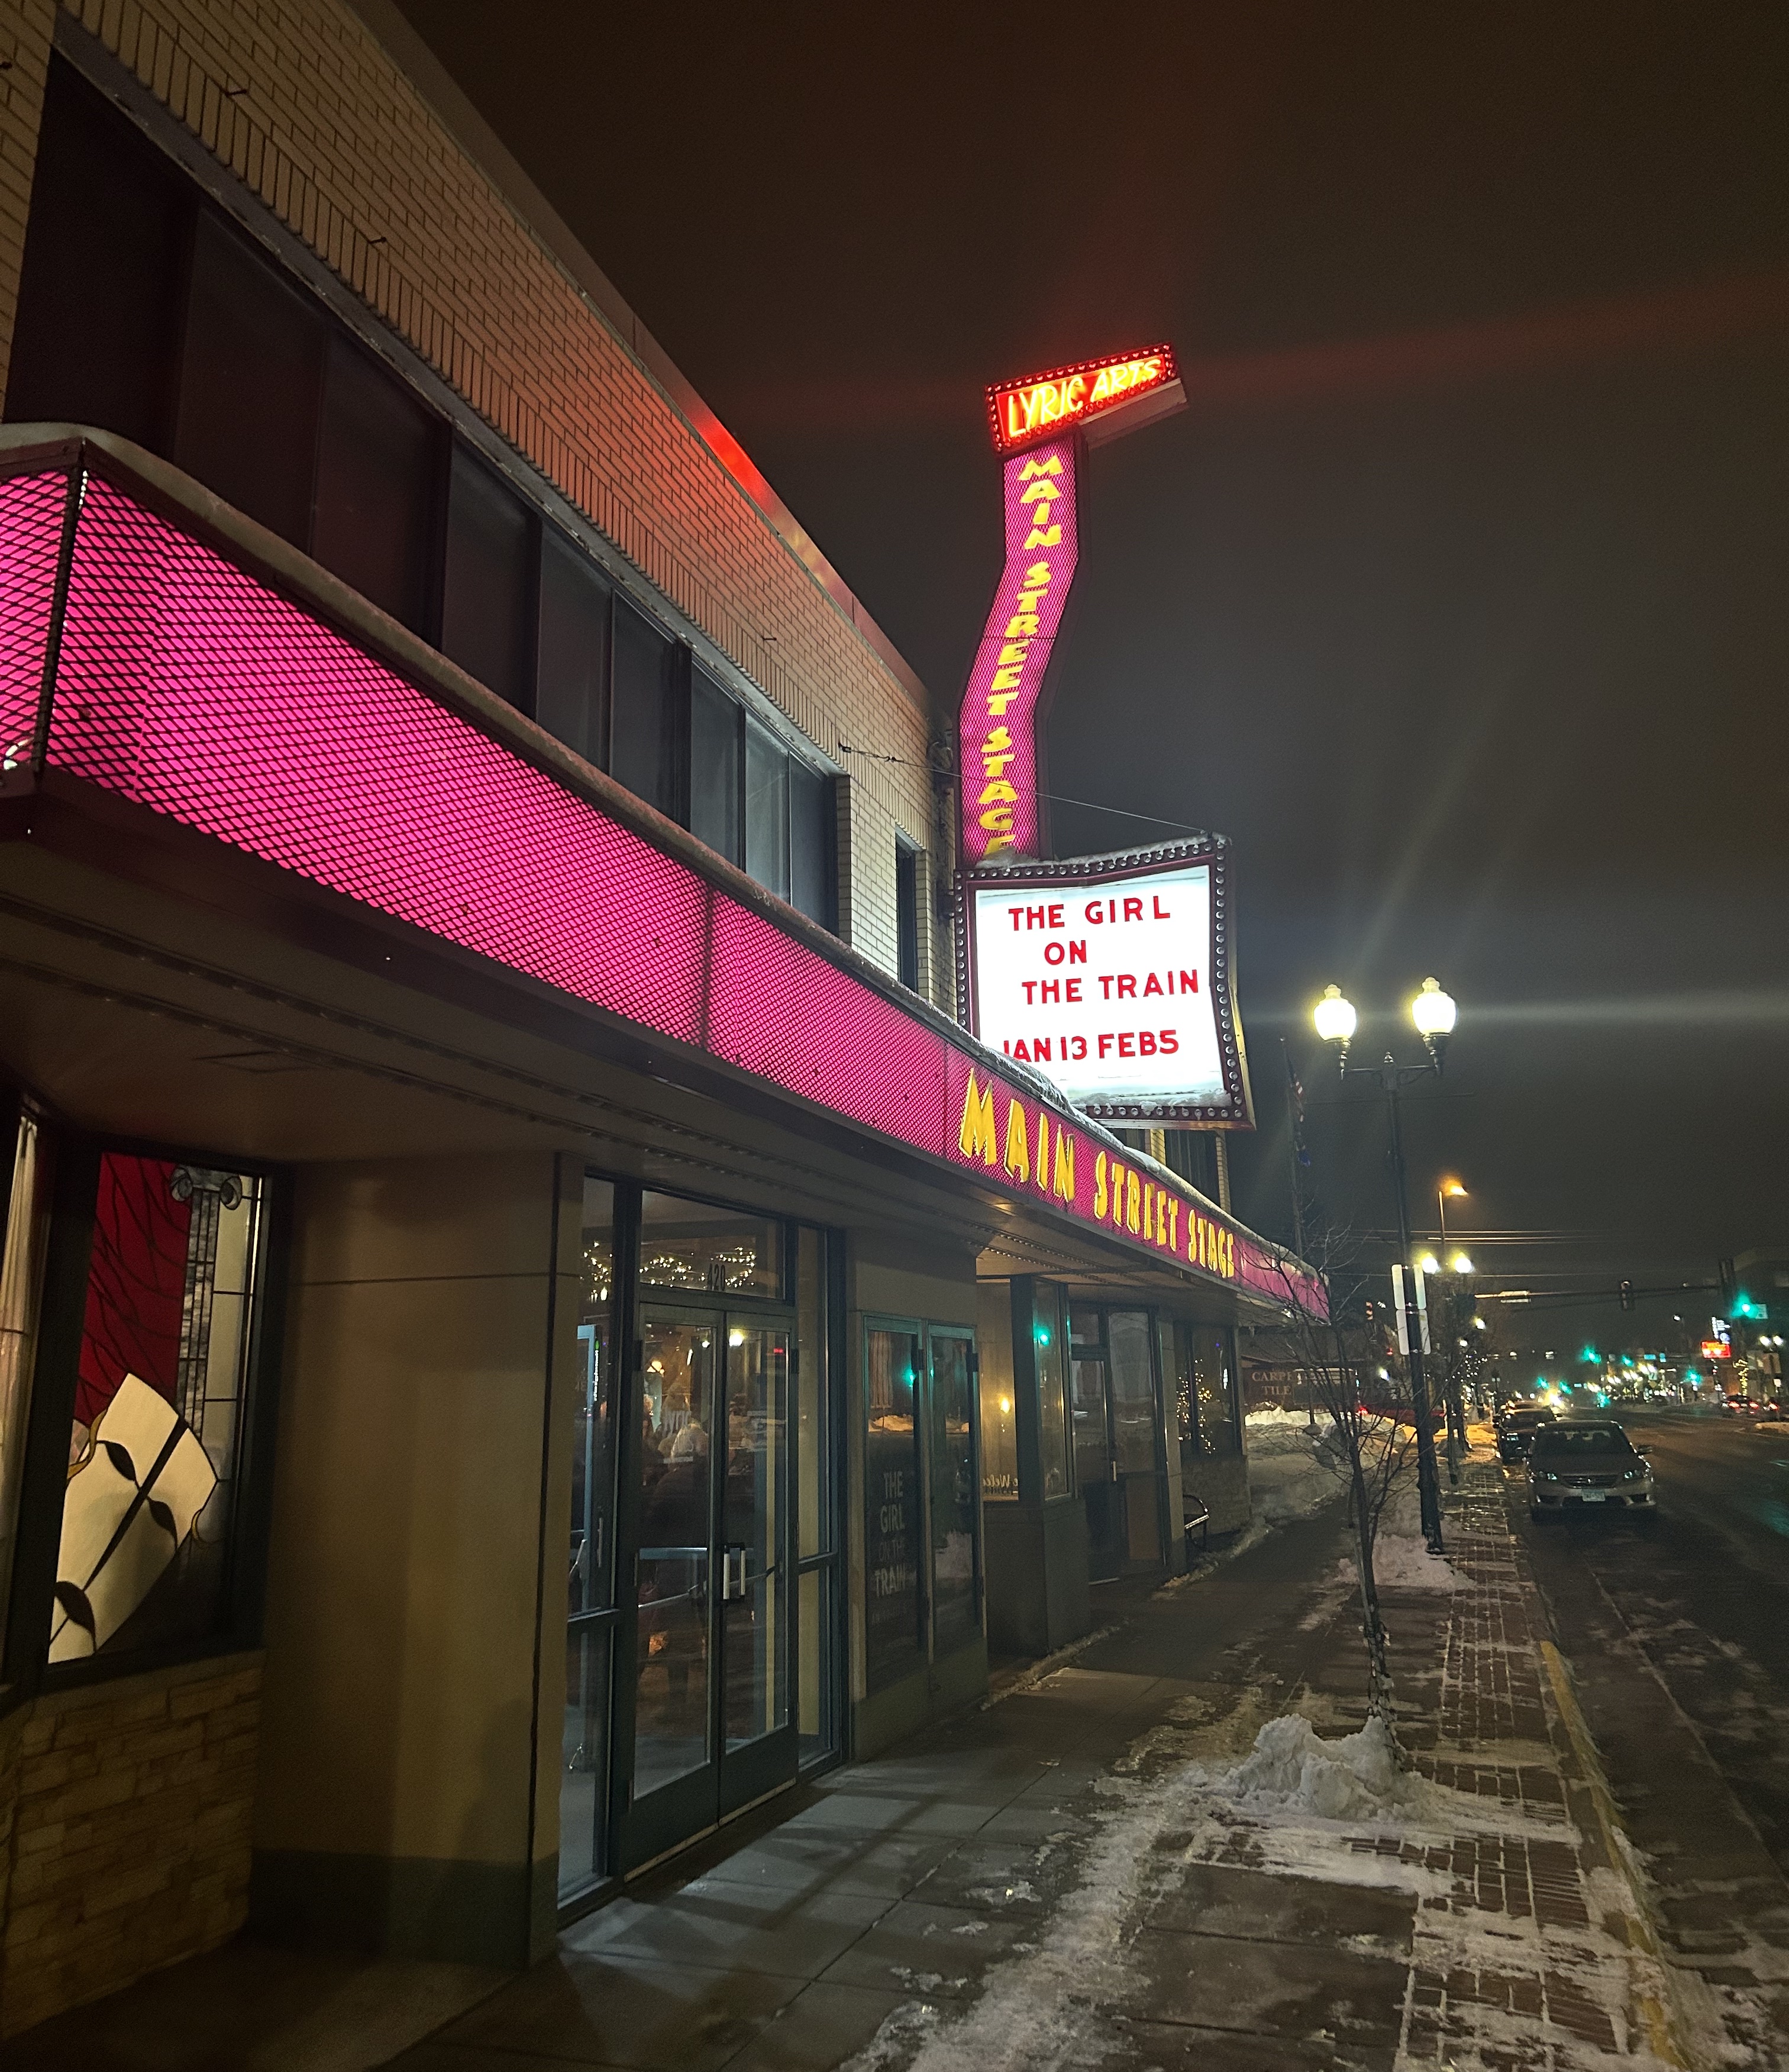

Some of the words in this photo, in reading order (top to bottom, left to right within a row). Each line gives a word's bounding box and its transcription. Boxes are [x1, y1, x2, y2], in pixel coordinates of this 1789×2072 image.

[1008, 377, 1084, 437] LYRIC
[1090, 358, 1161, 403] ARTS
[1017, 454, 1063, 550] MAIN
[986, 561, 1051, 716] STREET
[1008, 904, 1065, 931] THE
[1084, 895, 1171, 925] GIRL
[1044, 940, 1087, 966] ON
[1022, 977, 1083, 1005] THE
[1098, 969, 1199, 1000] TRAIN
[959, 1067, 1076, 1202] MAIN
[1094, 1151, 1178, 1252] STREET
[1189, 1209, 1235, 1279] STAGE
[883, 1471, 903, 1499] THE
[880, 1503, 906, 1534] GIRL
